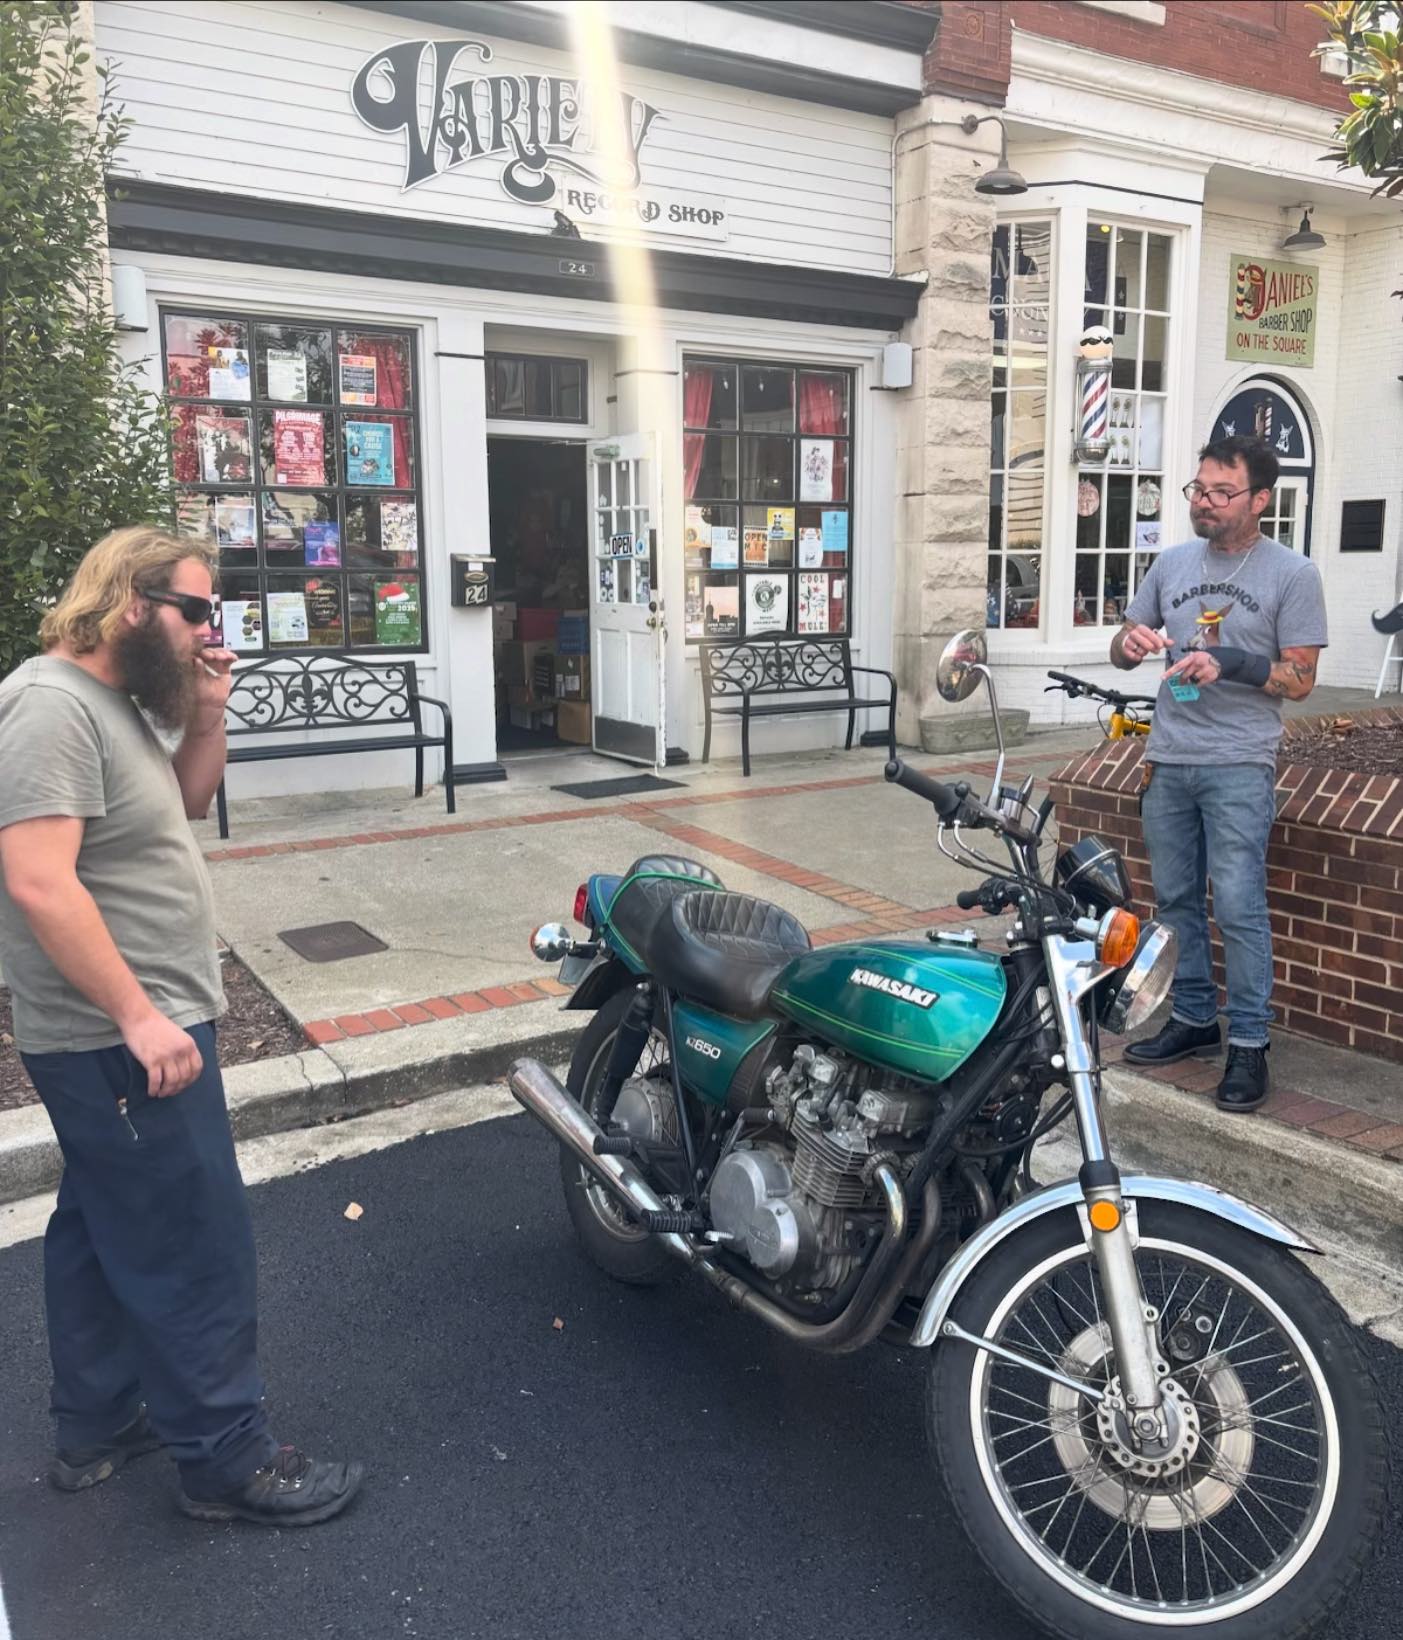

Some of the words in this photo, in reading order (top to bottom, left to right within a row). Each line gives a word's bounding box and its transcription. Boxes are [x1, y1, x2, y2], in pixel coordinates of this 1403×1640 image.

[351, 39, 669, 206] VARIEY
[567, 189, 661, 223] RECRD
[668, 204, 725, 226] SHOP
[568, 263, 587, 274] 24
[1259, 313, 1288, 331] BARBER
[1290, 308, 1312, 333] SHOP
[1236, 332, 1250, 348] ON
[1253, 333, 1268, 350] THE
[1273, 335, 1306, 355] SQUARE
[612, 536, 632, 555] OPEN
[744, 532, 768, 542] OPEN
[800, 574, 825, 584] COOL
[468, 586, 487, 602] 24
[1171, 582, 1260, 614] BARBERSHOP
[799, 621, 825, 631] MULE
[850, 968, 937, 1008] KAWASAKI
